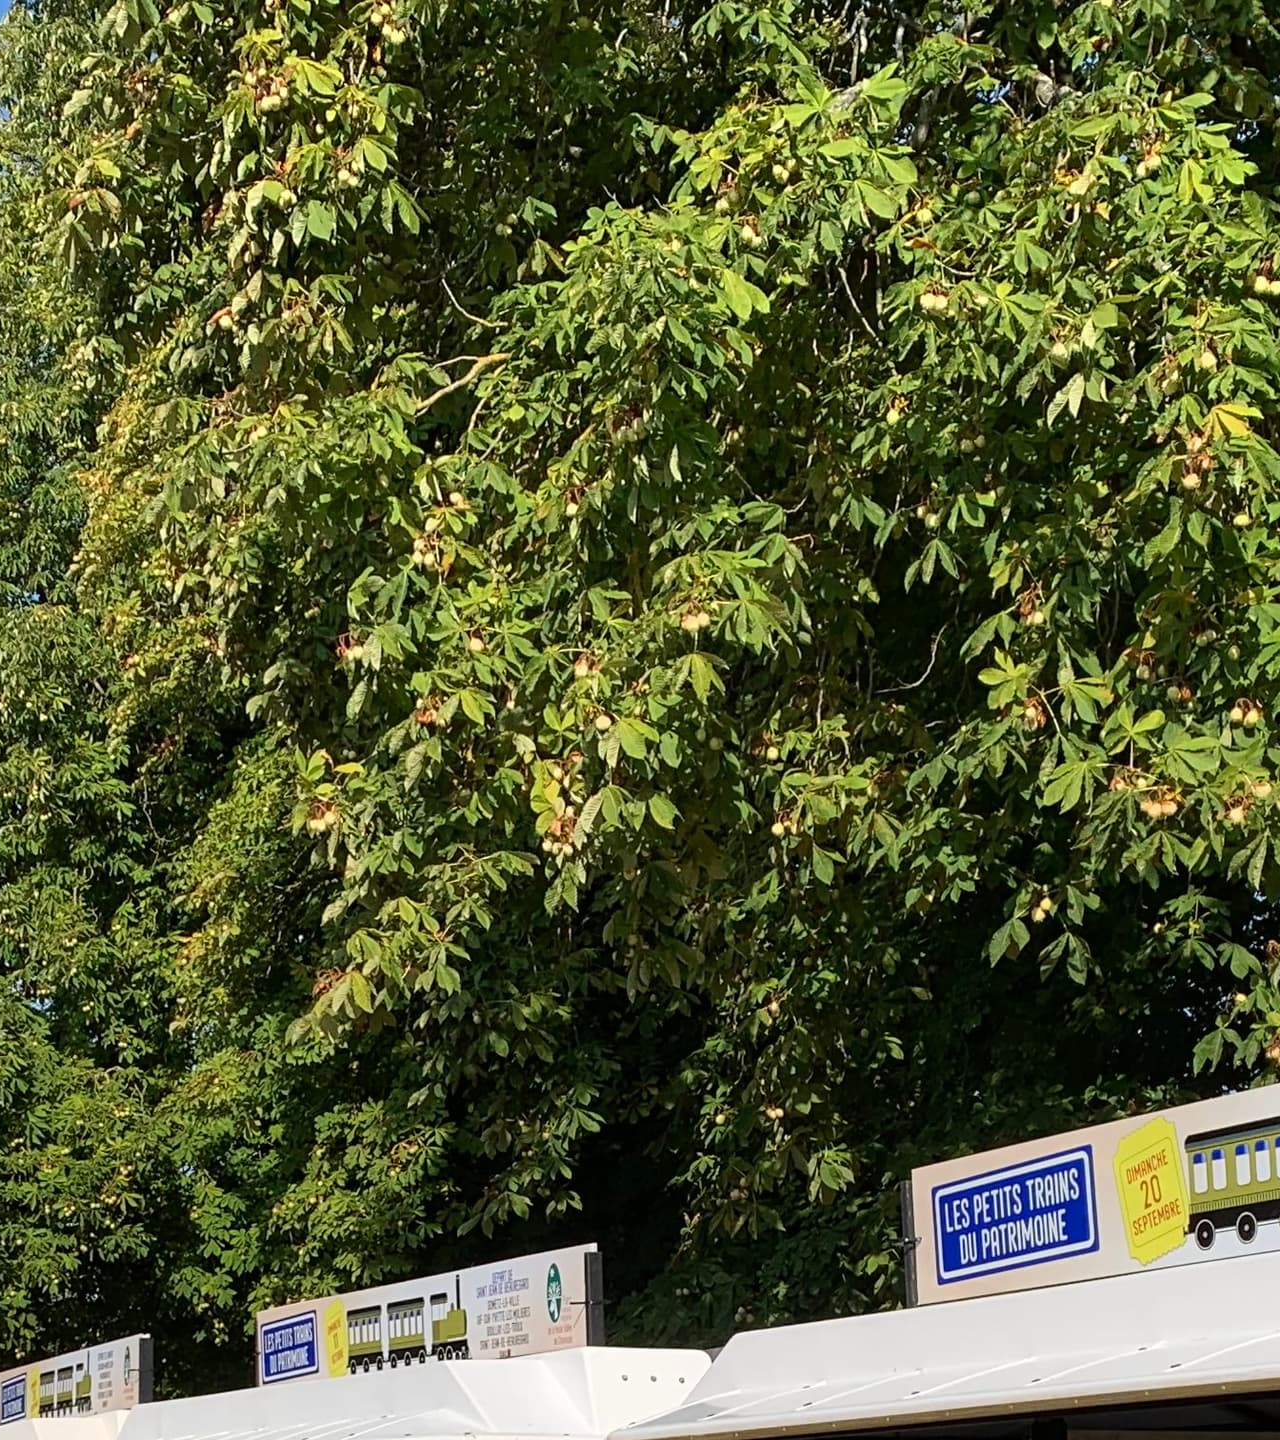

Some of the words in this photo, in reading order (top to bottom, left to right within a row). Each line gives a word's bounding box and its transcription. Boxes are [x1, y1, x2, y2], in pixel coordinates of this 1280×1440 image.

[1126, 1149, 1168, 1185] DIMANCHE
[944, 1198, 970, 1233] LES
[973, 1183, 1023, 1226] PETITS
[1025, 1167, 1080, 1211] TRAINS
[1140, 1174, 1162, 1210] 20
[1132, 1198, 1182, 1236] SEPTEMBRE
[959, 1231, 978, 1265] DU
[981, 1208, 1068, 1259] PATRIMOINE
